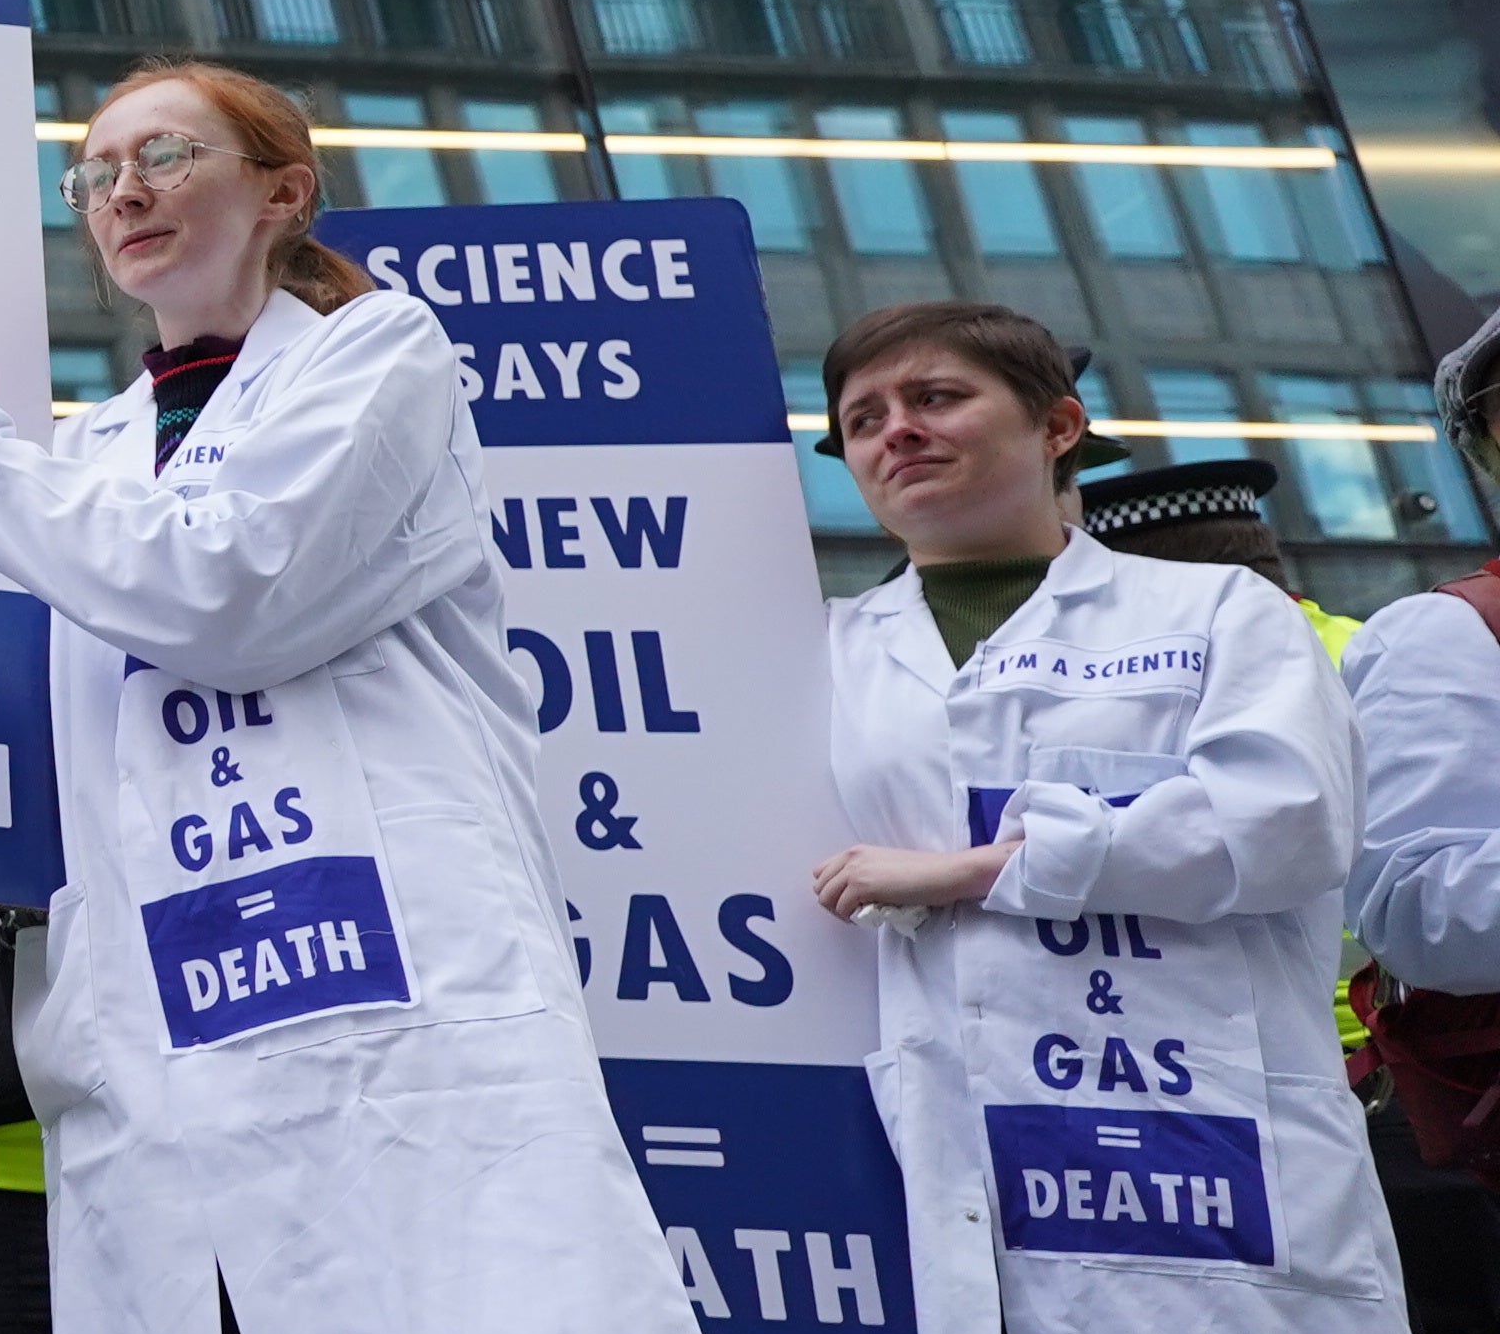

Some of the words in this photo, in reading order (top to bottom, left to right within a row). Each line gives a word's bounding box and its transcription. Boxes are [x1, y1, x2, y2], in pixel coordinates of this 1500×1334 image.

[366, 238, 695, 306] SCIENCE
[452, 339, 641, 402] SAYS
[490, 496, 688, 569] NEW
[506, 627, 701, 734] OIL
[999, 653, 1037, 675] I'M
[1052, 658, 1068, 676] A
[1083, 650, 1202, 680] SCIENTIS
[161, 689, 273, 745] OIL
[210, 746, 244, 787] &
[170, 786, 313, 872] GAS
[575, 771, 643, 851] &
[181, 920, 366, 1012] DEATH
[565, 892, 794, 1008] AS
[1035, 913, 1162, 959] OIL
[1086, 969, 1124, 1015] &
[1033, 1033, 1193, 1096] GAS
[1022, 1169, 1234, 1228] DEATH
[665, 1225, 885, 1326] ATH
